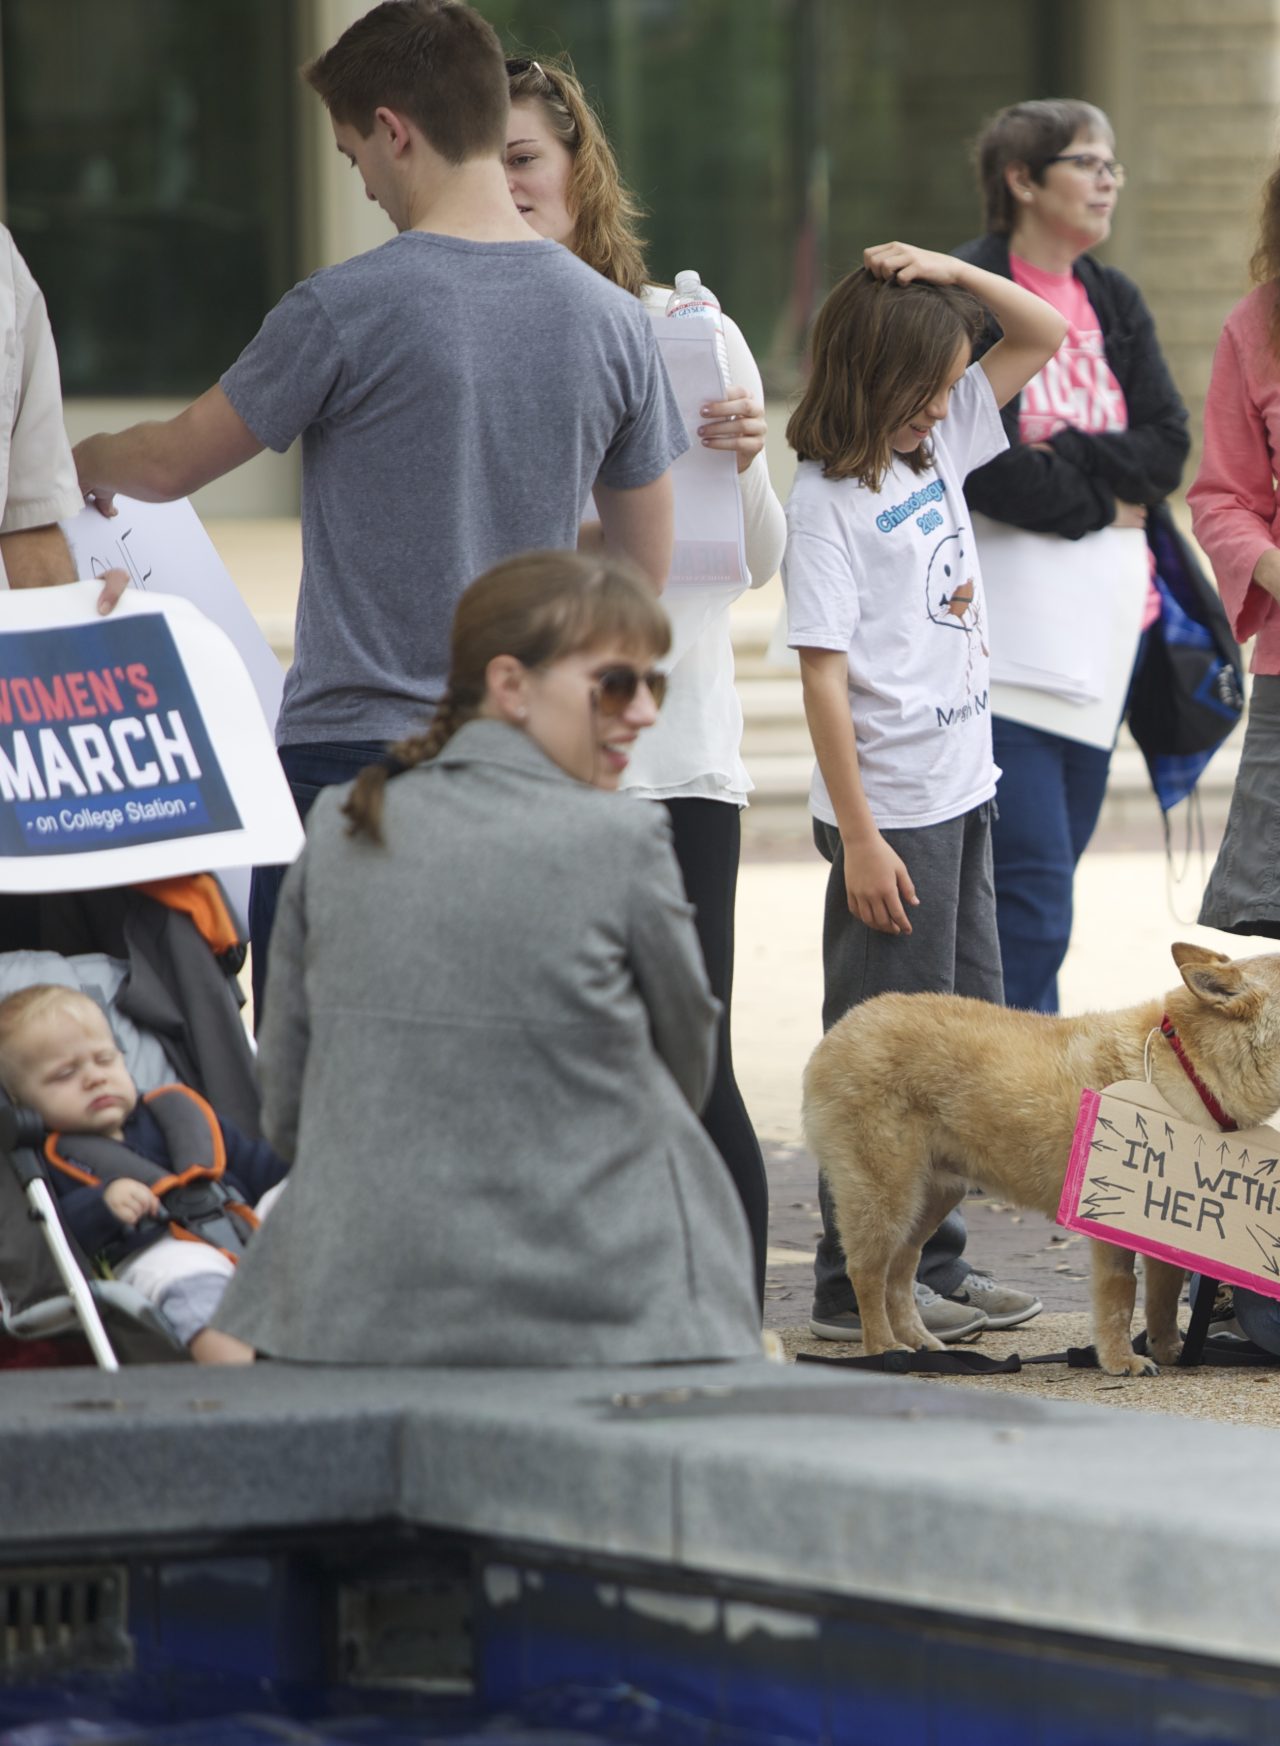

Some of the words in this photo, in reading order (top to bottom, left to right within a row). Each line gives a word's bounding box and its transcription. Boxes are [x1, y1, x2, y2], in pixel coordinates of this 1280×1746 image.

[0, 710, 202, 800] MARCH
[36, 817, 58, 833] on
[59, 806, 124, 832] College
[125, 797, 186, 822] Station
[1143, 1181, 1226, 1240] HER
[1194, 1161, 1277, 1215] WITH
